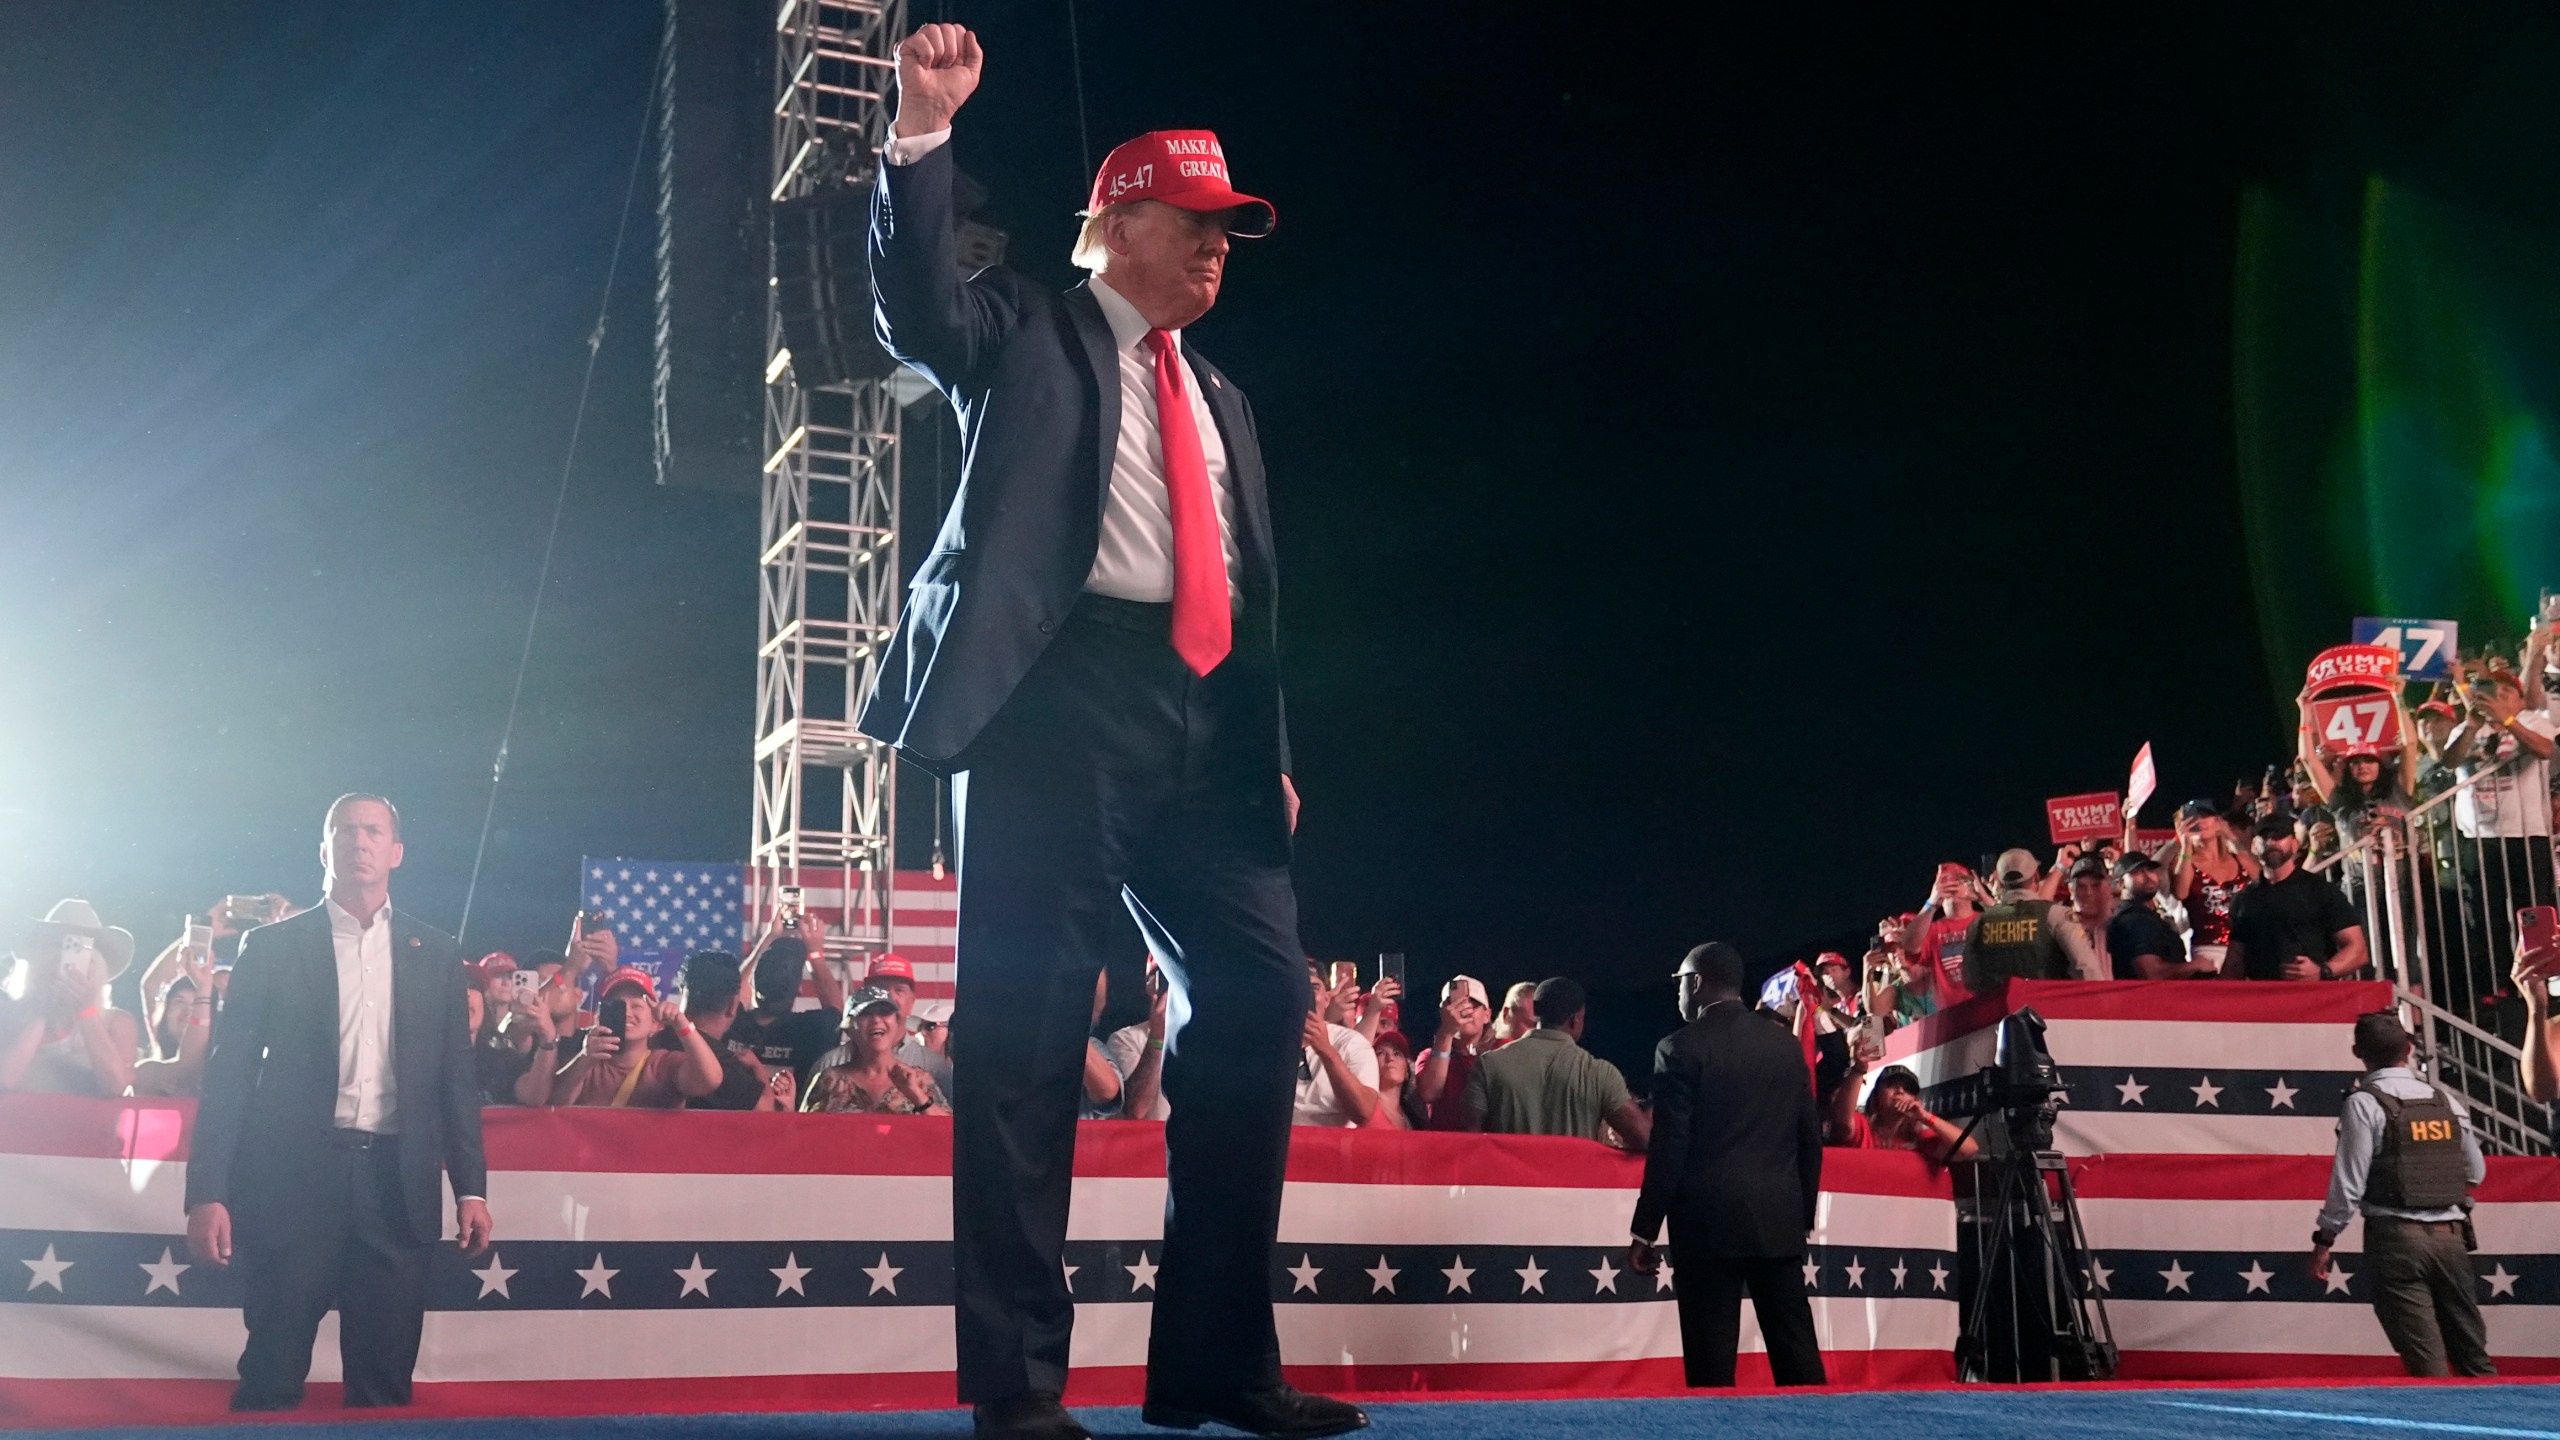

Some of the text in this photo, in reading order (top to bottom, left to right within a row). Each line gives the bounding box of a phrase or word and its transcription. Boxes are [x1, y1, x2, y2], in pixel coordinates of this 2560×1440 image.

[1165, 139, 1209, 155] MAKE
[1180, 160, 1222, 179] GREAT
[1108, 164, 1153, 197] 45-47
[2309, 655, 2392, 678] TRUMP
[2314, 664, 2383, 681] VANCE
[2325, 700, 2391, 746] 47
[2052, 803, 2116, 820] TRUMP
[2062, 815, 2111, 828] VANCE
[1982, 918, 2039, 944] SHERIFF
[1762, 969, 1796, 1004] 47
[2410, 1120, 2452, 1141] HSI
